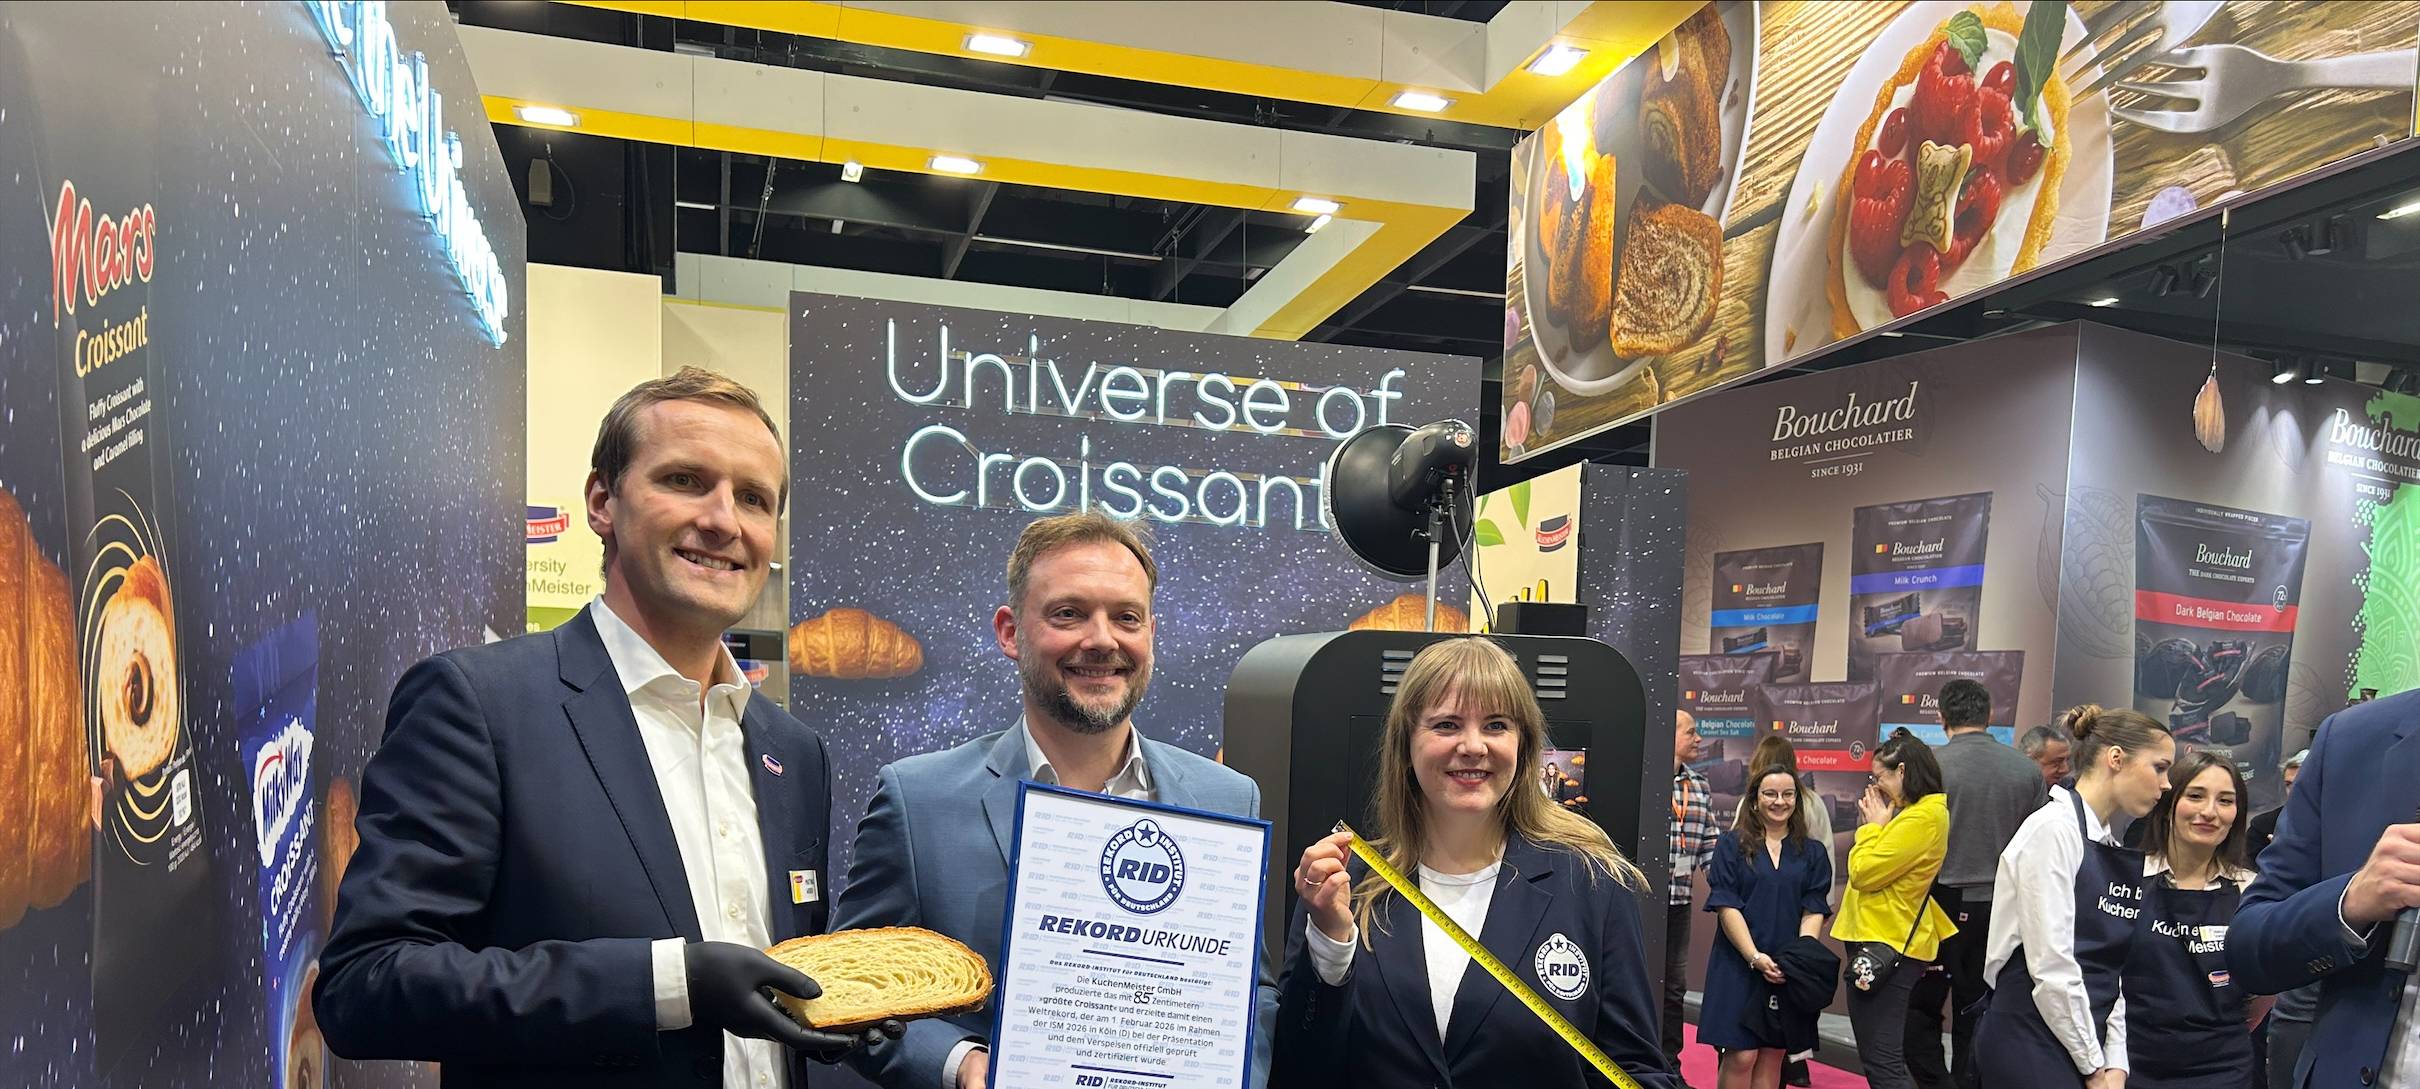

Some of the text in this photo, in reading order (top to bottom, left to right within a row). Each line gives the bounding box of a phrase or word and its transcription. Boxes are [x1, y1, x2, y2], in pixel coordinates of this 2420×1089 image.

[52, 179, 156, 330] Mars
[75, 305, 148, 378] Croissant
[886, 318, 1406, 440] Universe of
[106, 384, 132, 413] Croissant
[131, 377, 144, 400] with
[1771, 381, 1919, 442] Bouchard
[86, 424, 112, 451] delicious
[112, 414, 126, 437] Mars
[125, 399, 151, 428] Chocolate
[1770, 428, 1913, 461] BELGIAN CHOCOLATIER
[93, 449, 105, 472] and
[105, 437, 129, 464] Caramel
[2327, 450, 2365, 468] BELGIAN
[1811, 462, 1864, 478] SINCE 1931
[2356, 483, 2391, 500] SINCE 1931
[1893, 538, 1944, 555] Bouchard
[2196, 543, 2253, 569] Bouchard
[2189, 569, 2200, 577] THE
[1895, 575, 1937, 585] Milk Crunch
[1746, 581, 1787, 595] Bouchard
[2175, 603, 2262, 623] Dark Belgian Chocolate
[1700, 689, 1745, 703] Bouchard
[1701, 720, 1724, 729] Belgian
[1789, 720, 1838, 734] Bouchard
[1803, 755, 1838, 764] Chocolate
[1034, 811, 1051, 821] RID
[1067, 832, 1084, 841] RID
[1032, 842, 1049, 850] RID
[1237, 845, 1253, 854] RID
[270, 798, 315, 916] CROISSANT
[1103, 830, 1184, 888] REKORD INSTITUT
[1203, 853, 1219, 862] RID
[1064, 862, 1081, 871] RID
[1117, 858, 1170, 884] RID
[1028, 872, 1045, 880] RID
[1234, 873, 1249, 882] RID
[1200, 883, 1216, 892] RID
[2108, 882, 2131, 898] Ich
[1061, 892, 1078, 900] RID
[1108, 883, 1174, 912] FÜR DEUTSCHLAND
[1025, 902, 1042, 911] RID
[1232, 902, 1247, 911] RID
[1095, 911, 1112, 920] RID
[1197, 911, 1213, 920] RID
[1163, 922, 1179, 930] RID
[1022, 932, 1039, 941] RID
[1039, 914, 1231, 957] REKORDURKUNDE
[1229, 931, 1245, 940] RID
[1092, 942, 1109, 950] RID
[1055, 952, 1072, 961] RID
[1019, 963, 1036, 971] RID
[1226, 961, 1242, 969] RID
[1549, 964, 1580, 977] RID
[1134, 970, 1179, 982] DEUTSCHLAND
[1077, 975, 1182, 996] Die KuchenMeister GmbH
[1055, 985, 1133, 1002] produzierte das mit
[1133, 991, 1154, 1005] 85
[1224, 990, 1240, 998] RID
[1152, 997, 1200, 1010] Zentimetern
[1118, 1006, 1135, 1014] und
[1136, 1007, 1166, 1018] erzielte
[1167, 1010, 1190, 1021] damit
[1191, 1014, 1213, 1023] einen
[1028, 1006, 1078, 1020] Weltrekord,
[1079, 1011, 1095, 1022] der
[1096, 1016, 1109, 1024] am
[1120, 1017, 1153, 1028] Februar
[1154, 1021, 1175, 1032] 2026
[1176, 1024, 1187, 1033] im
[1188, 1026, 1221, 1037] Rahmen
[1012, 1024, 1029, 1033] RID
[1032, 1019, 1214, 1048] der ISM 2026 in Köln (D) bei der Präsentation
[1048, 1033, 1198, 1058] und dem Verspeisen offiziell geprüft
[1009, 1055, 1026, 1063] RID
[1076, 1049, 1167, 1066] und zertifiziert wurde
[1218, 1049, 1234, 1057] RID
[1184, 1060, 1200, 1068] RID
[1076, 1075, 1104, 1087] RID
[1109, 1077, 1167, 1089] REKORD-INSTITUT
